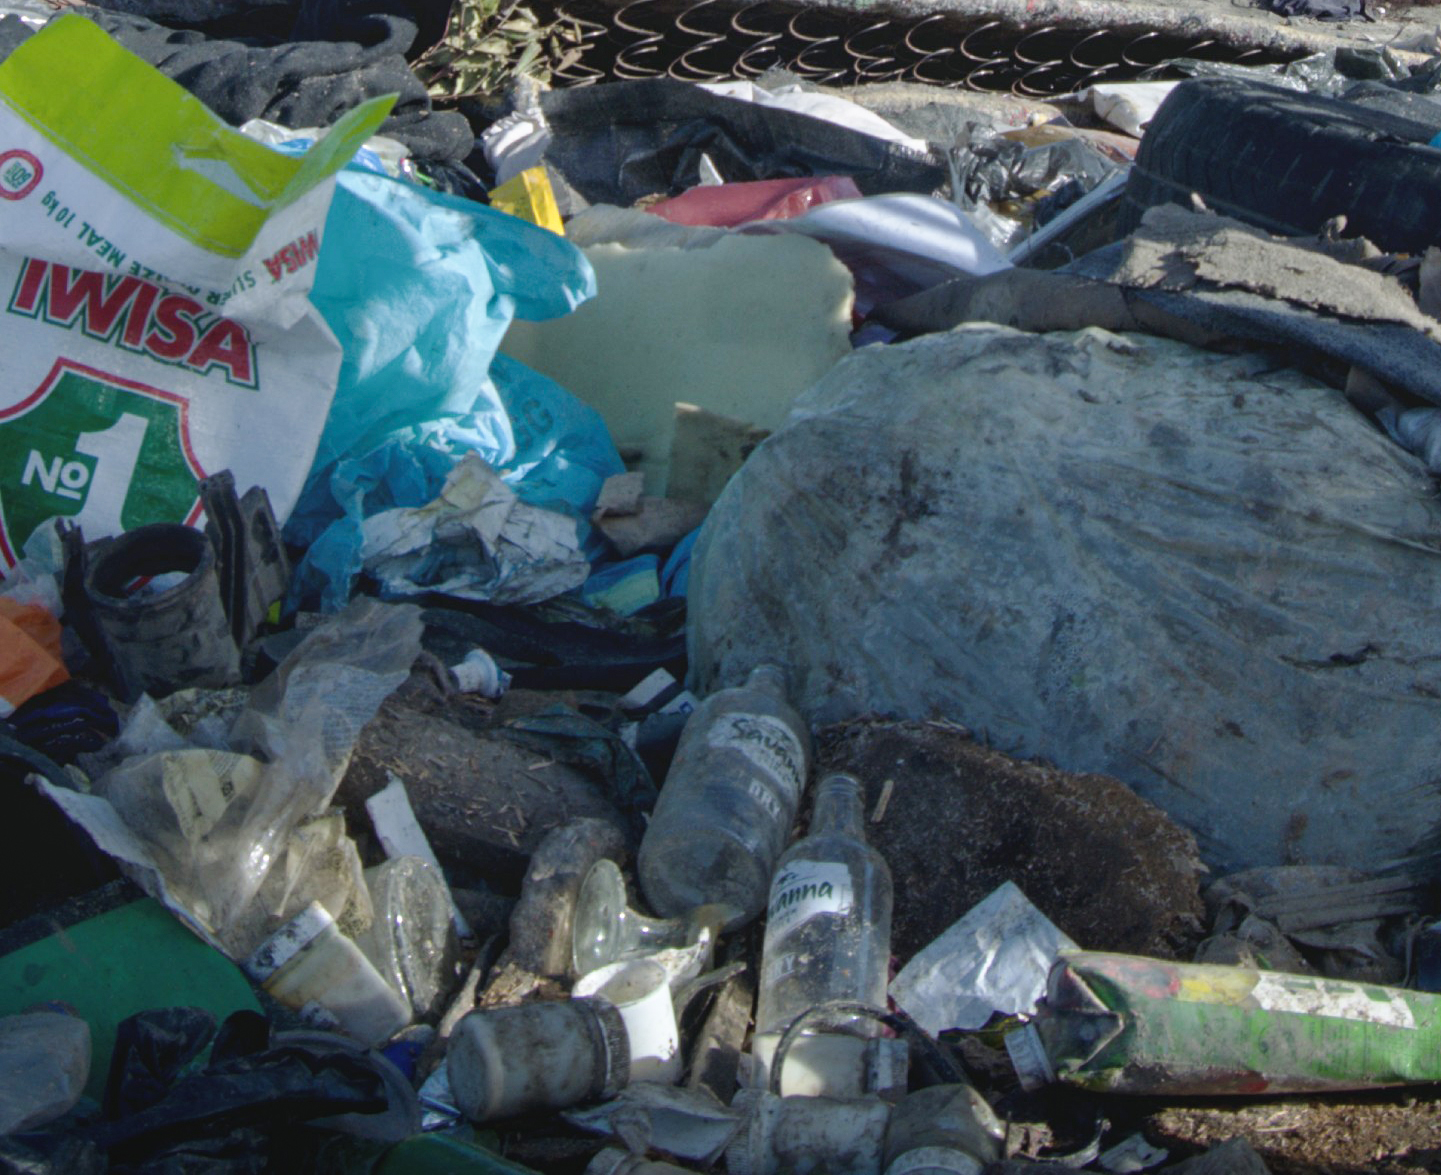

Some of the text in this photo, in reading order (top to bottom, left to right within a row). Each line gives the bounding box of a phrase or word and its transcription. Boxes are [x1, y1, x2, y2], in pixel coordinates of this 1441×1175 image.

[76, 221, 127, 269] MEAL
[7, 256, 260, 391] IWISA
[75, 412, 149, 544] 1
